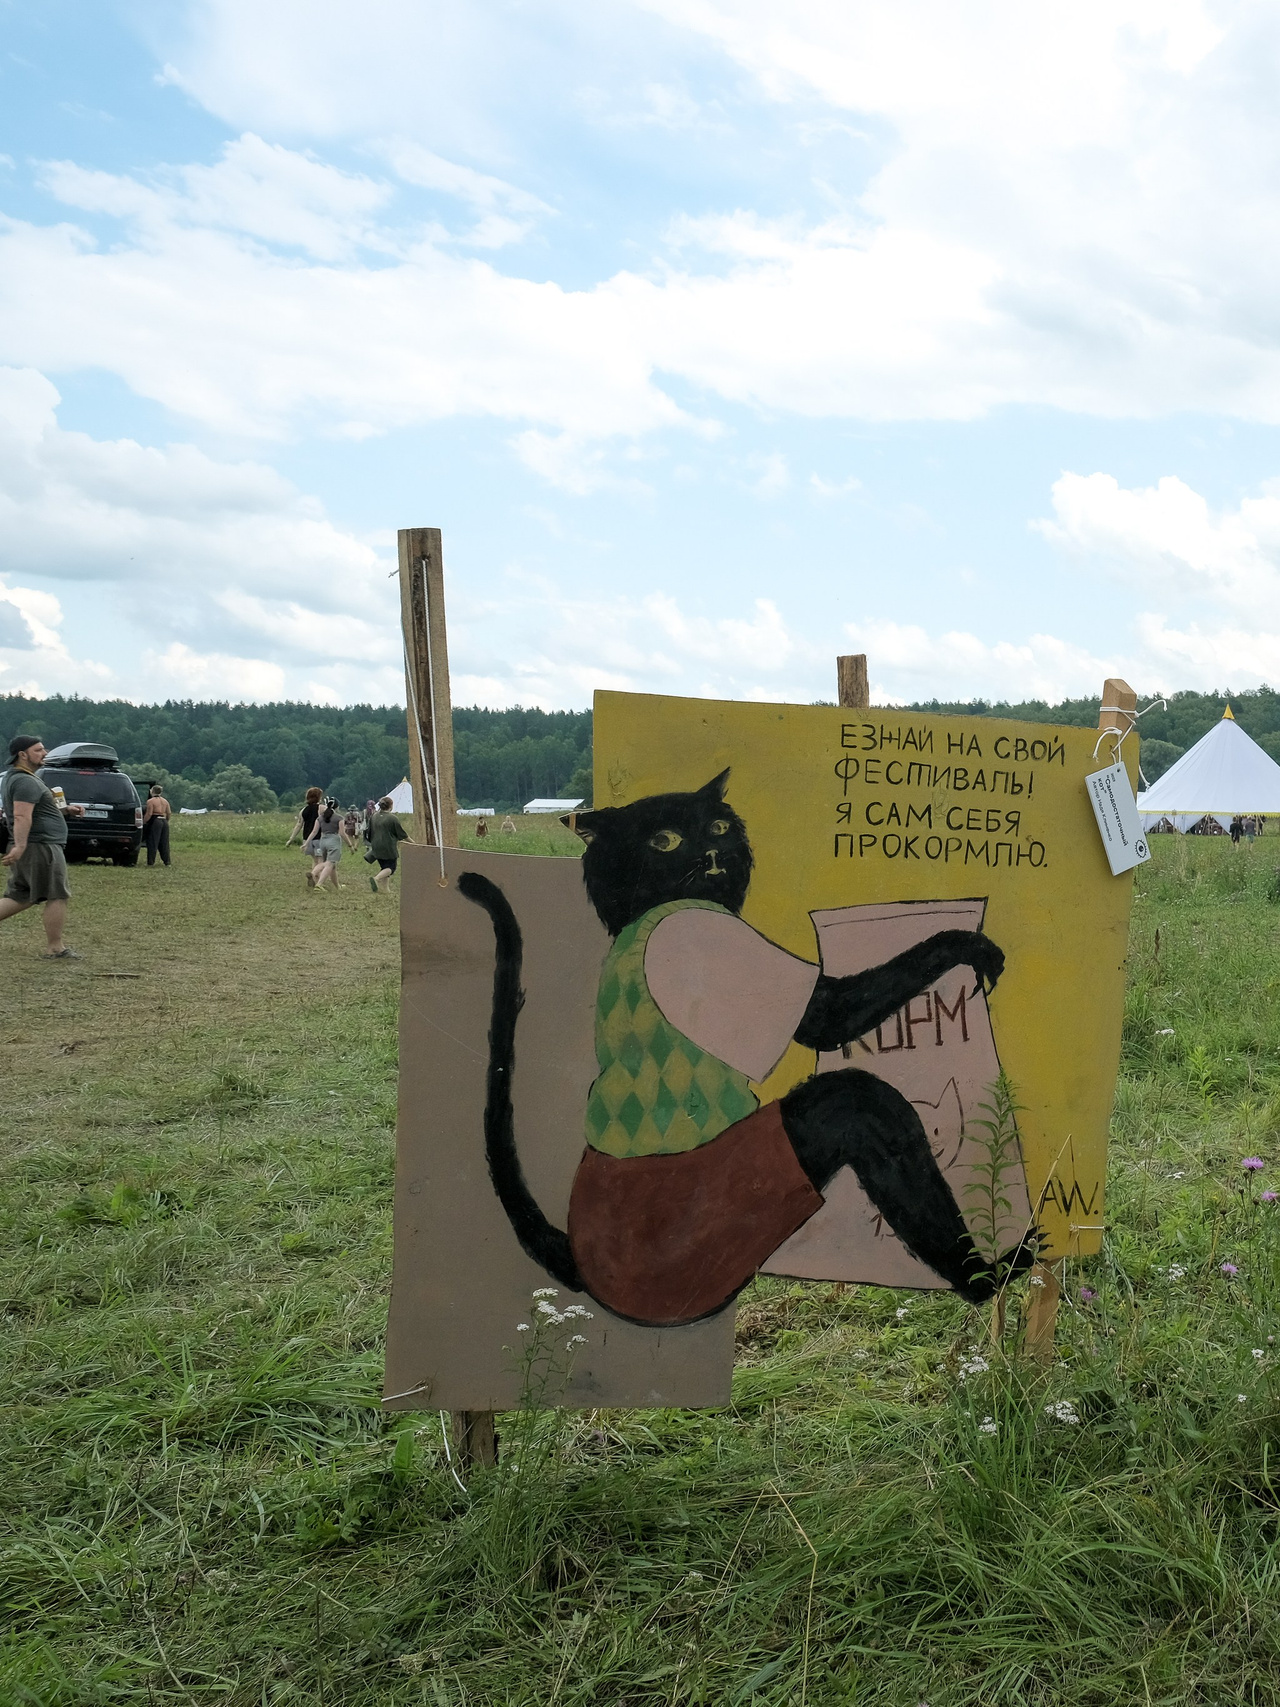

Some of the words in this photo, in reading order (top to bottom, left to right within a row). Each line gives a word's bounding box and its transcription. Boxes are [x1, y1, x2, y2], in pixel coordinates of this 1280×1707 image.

[841, 724, 933, 754] ЕЗЖАЙ
[947, 732, 982, 757] НА
[994, 735, 1065, 767] СВОЙ
[834, 752, 1034, 799] ФЕСТИВАЛЬ!
[836, 802, 851, 824] Я
[865, 801, 932, 829] САМ
[946, 806, 1021, 837] СЕБЯ
[834, 833, 1047, 868] ПРОКОРМЛЮ.
[842, 985, 970, 1059] ОРМ
